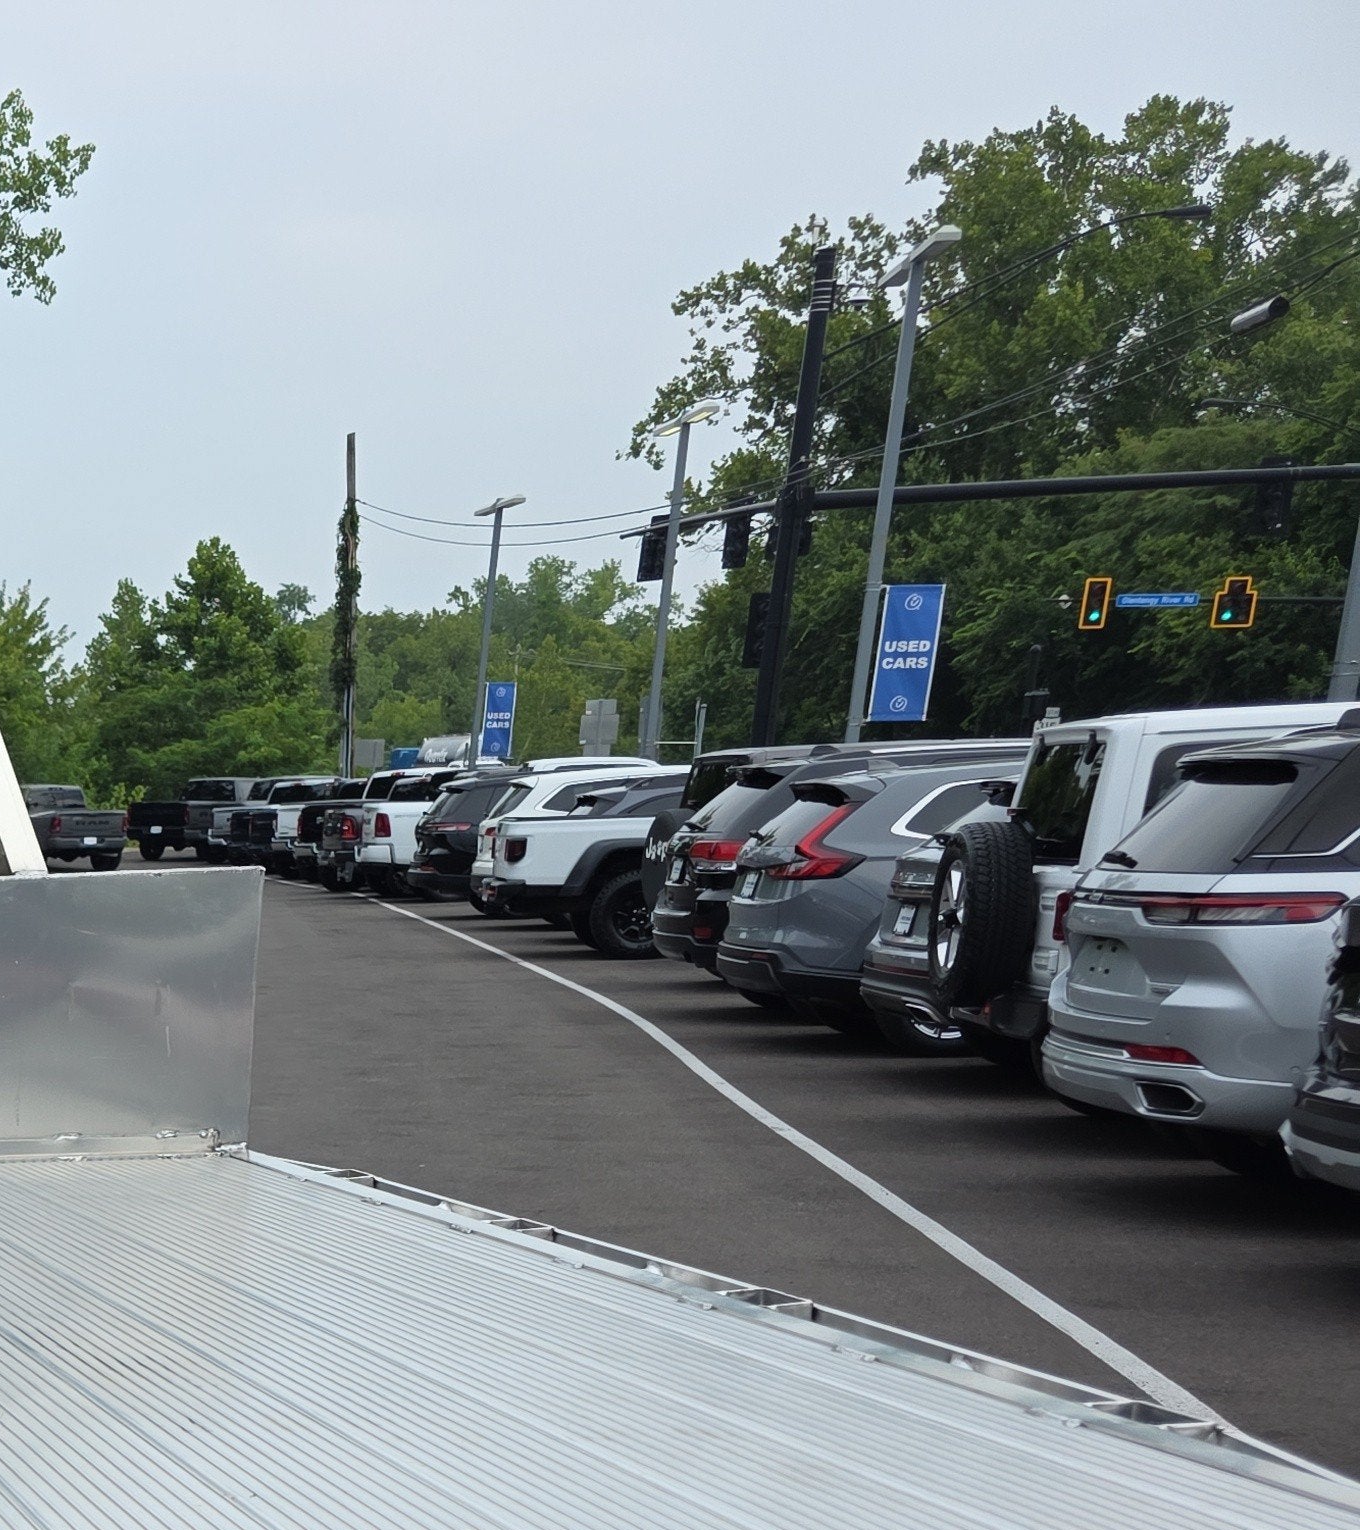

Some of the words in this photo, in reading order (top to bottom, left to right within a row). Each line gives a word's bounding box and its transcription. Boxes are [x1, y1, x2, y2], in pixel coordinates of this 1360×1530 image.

[884, 640, 931, 653] USED
[881, 656, 929, 669] CARS
[487, 712, 511, 720] USED
[486, 721, 510, 729] CARS
